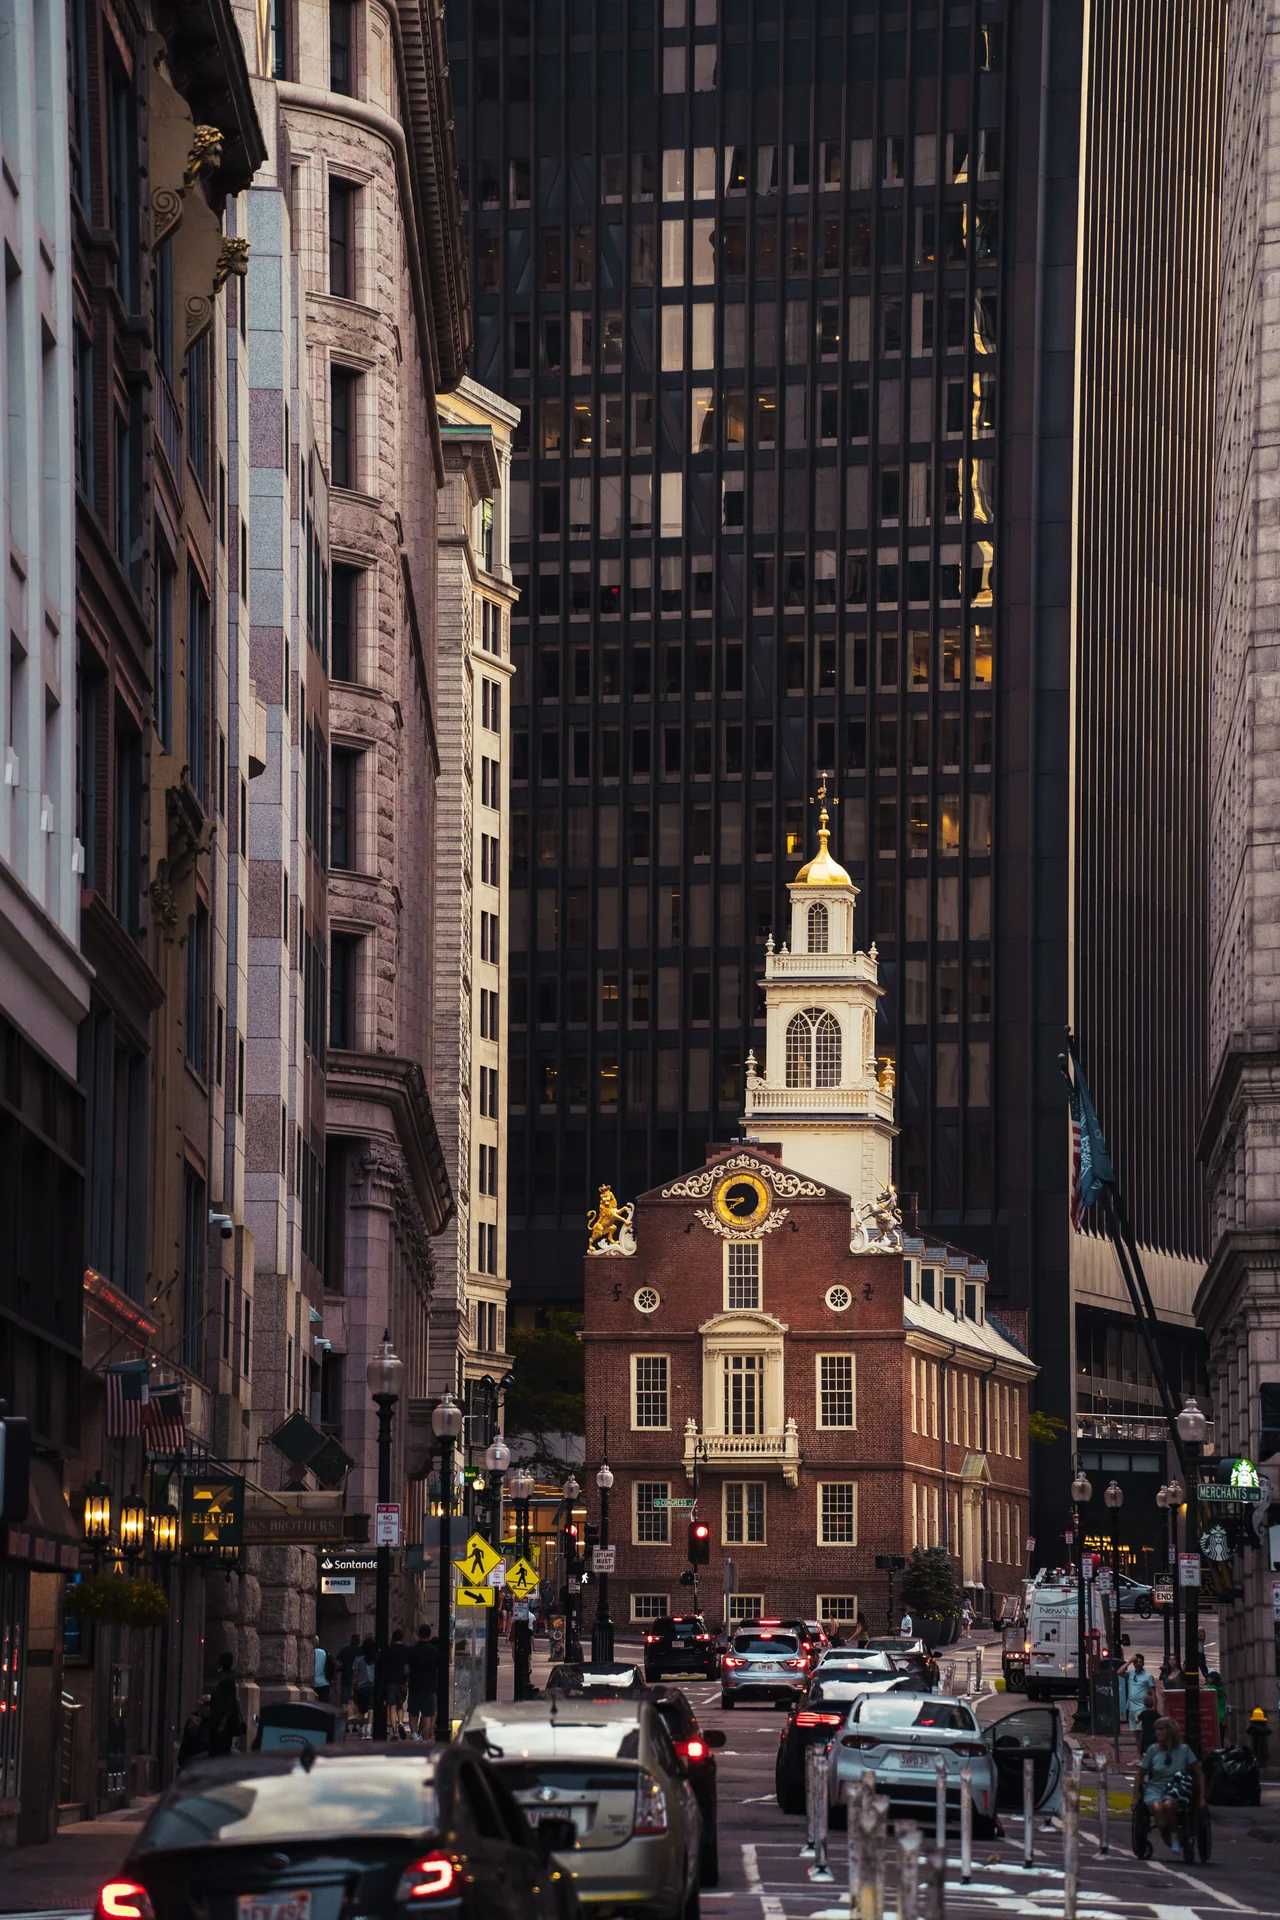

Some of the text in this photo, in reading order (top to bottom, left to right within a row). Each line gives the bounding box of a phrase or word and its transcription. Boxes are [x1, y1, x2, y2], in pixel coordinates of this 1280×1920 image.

[1200, 1486, 1247, 1499] MERCHANTS
[270, 1520, 335, 1531] BROTHERS
[334, 1560, 378, 1569] Santande
